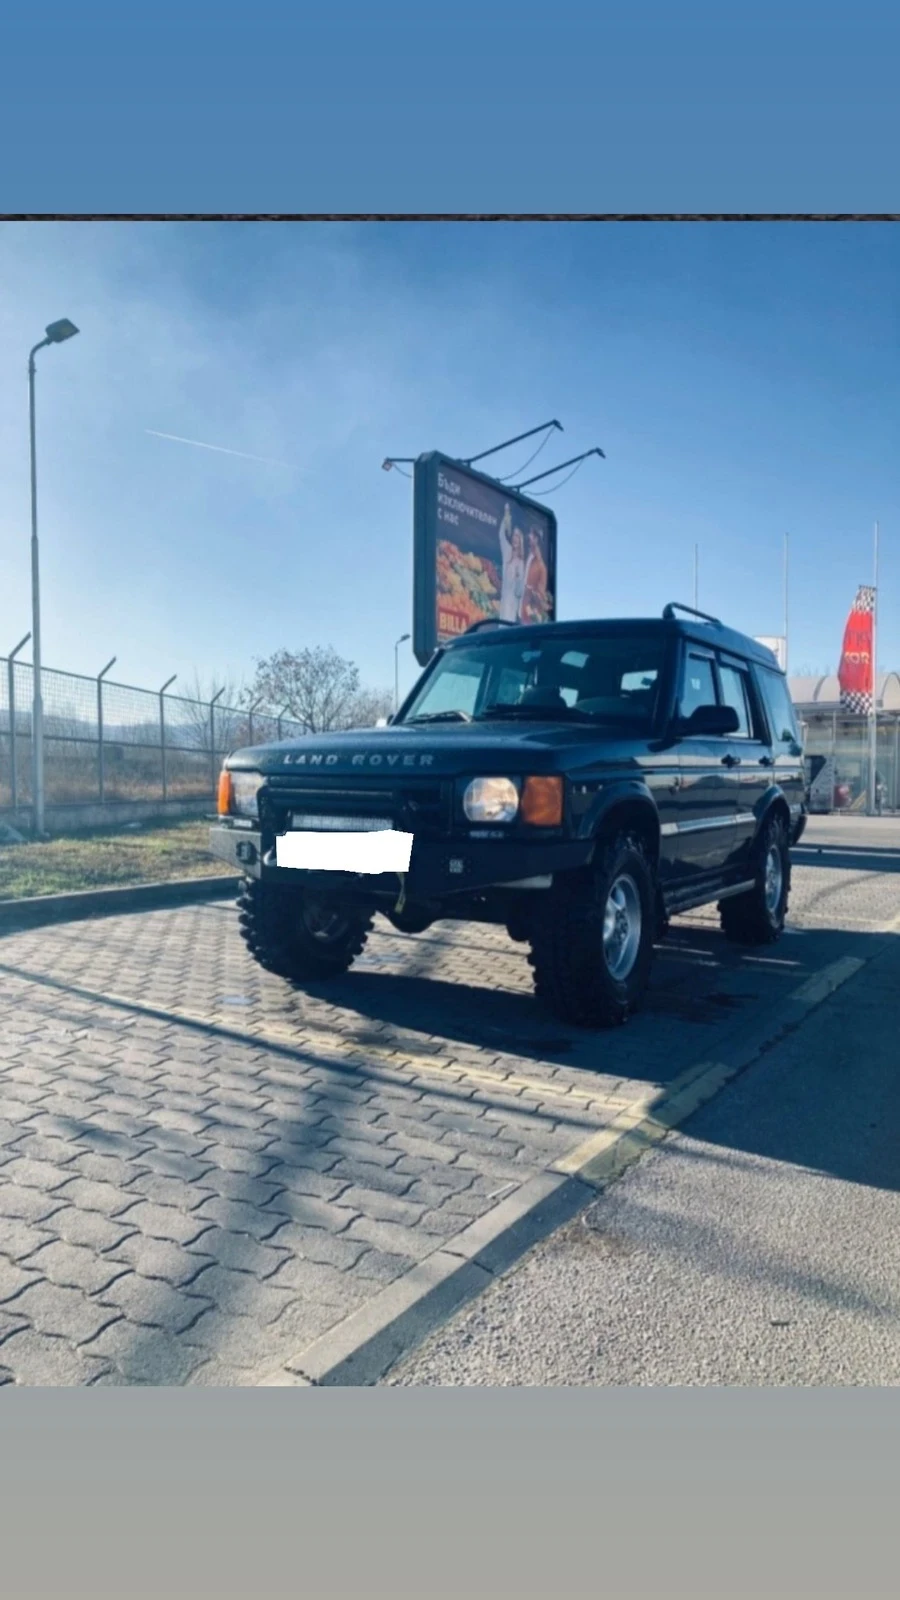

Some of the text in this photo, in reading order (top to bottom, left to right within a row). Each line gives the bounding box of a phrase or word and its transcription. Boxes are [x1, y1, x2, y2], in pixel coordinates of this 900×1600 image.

[439, 612, 468, 634] BILLA
[283, 754, 434, 766] LAND ROVER
